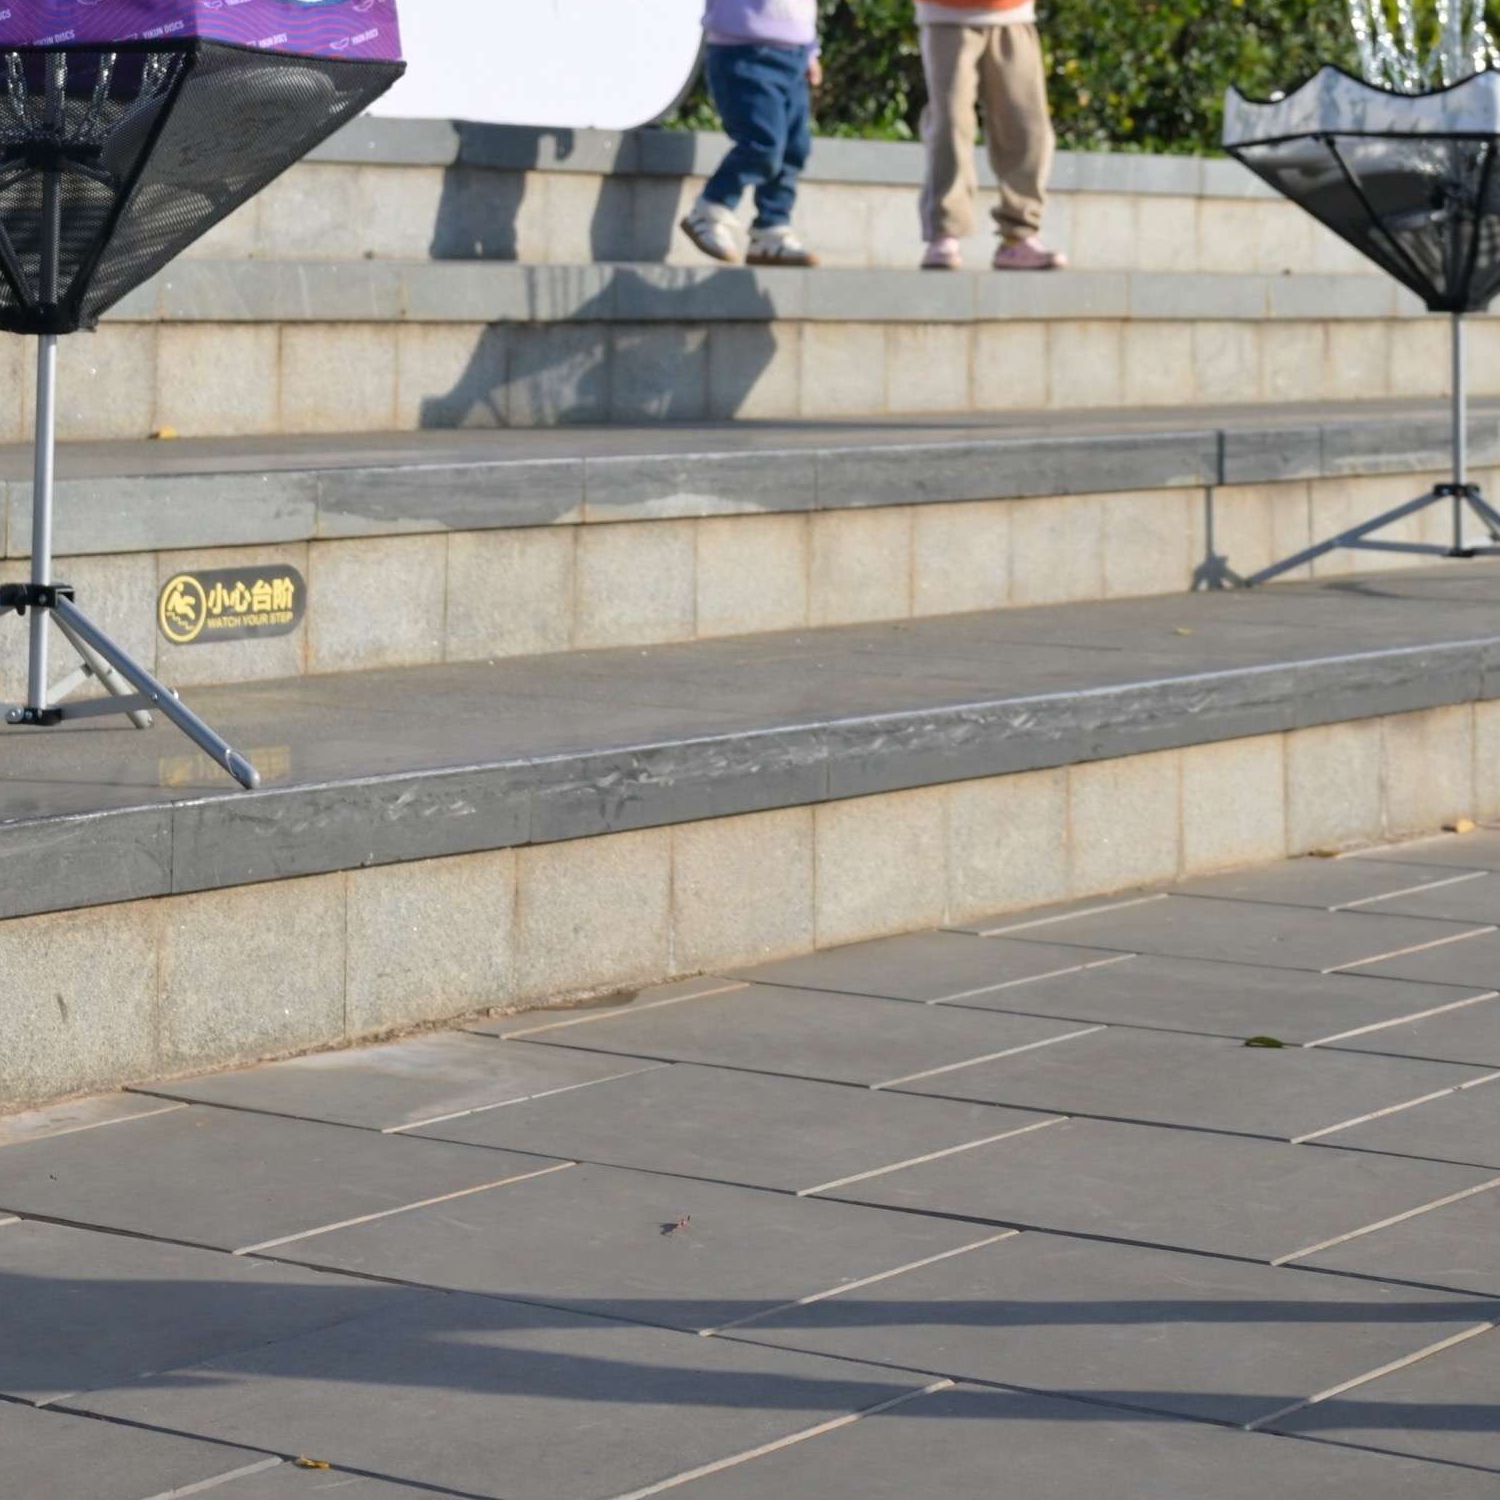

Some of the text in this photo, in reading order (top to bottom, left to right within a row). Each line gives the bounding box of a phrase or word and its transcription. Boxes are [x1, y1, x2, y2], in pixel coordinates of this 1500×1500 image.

[143, 20, 184, 39] YIKUN DISCS
[208, 576, 294, 615] 小心台阶
